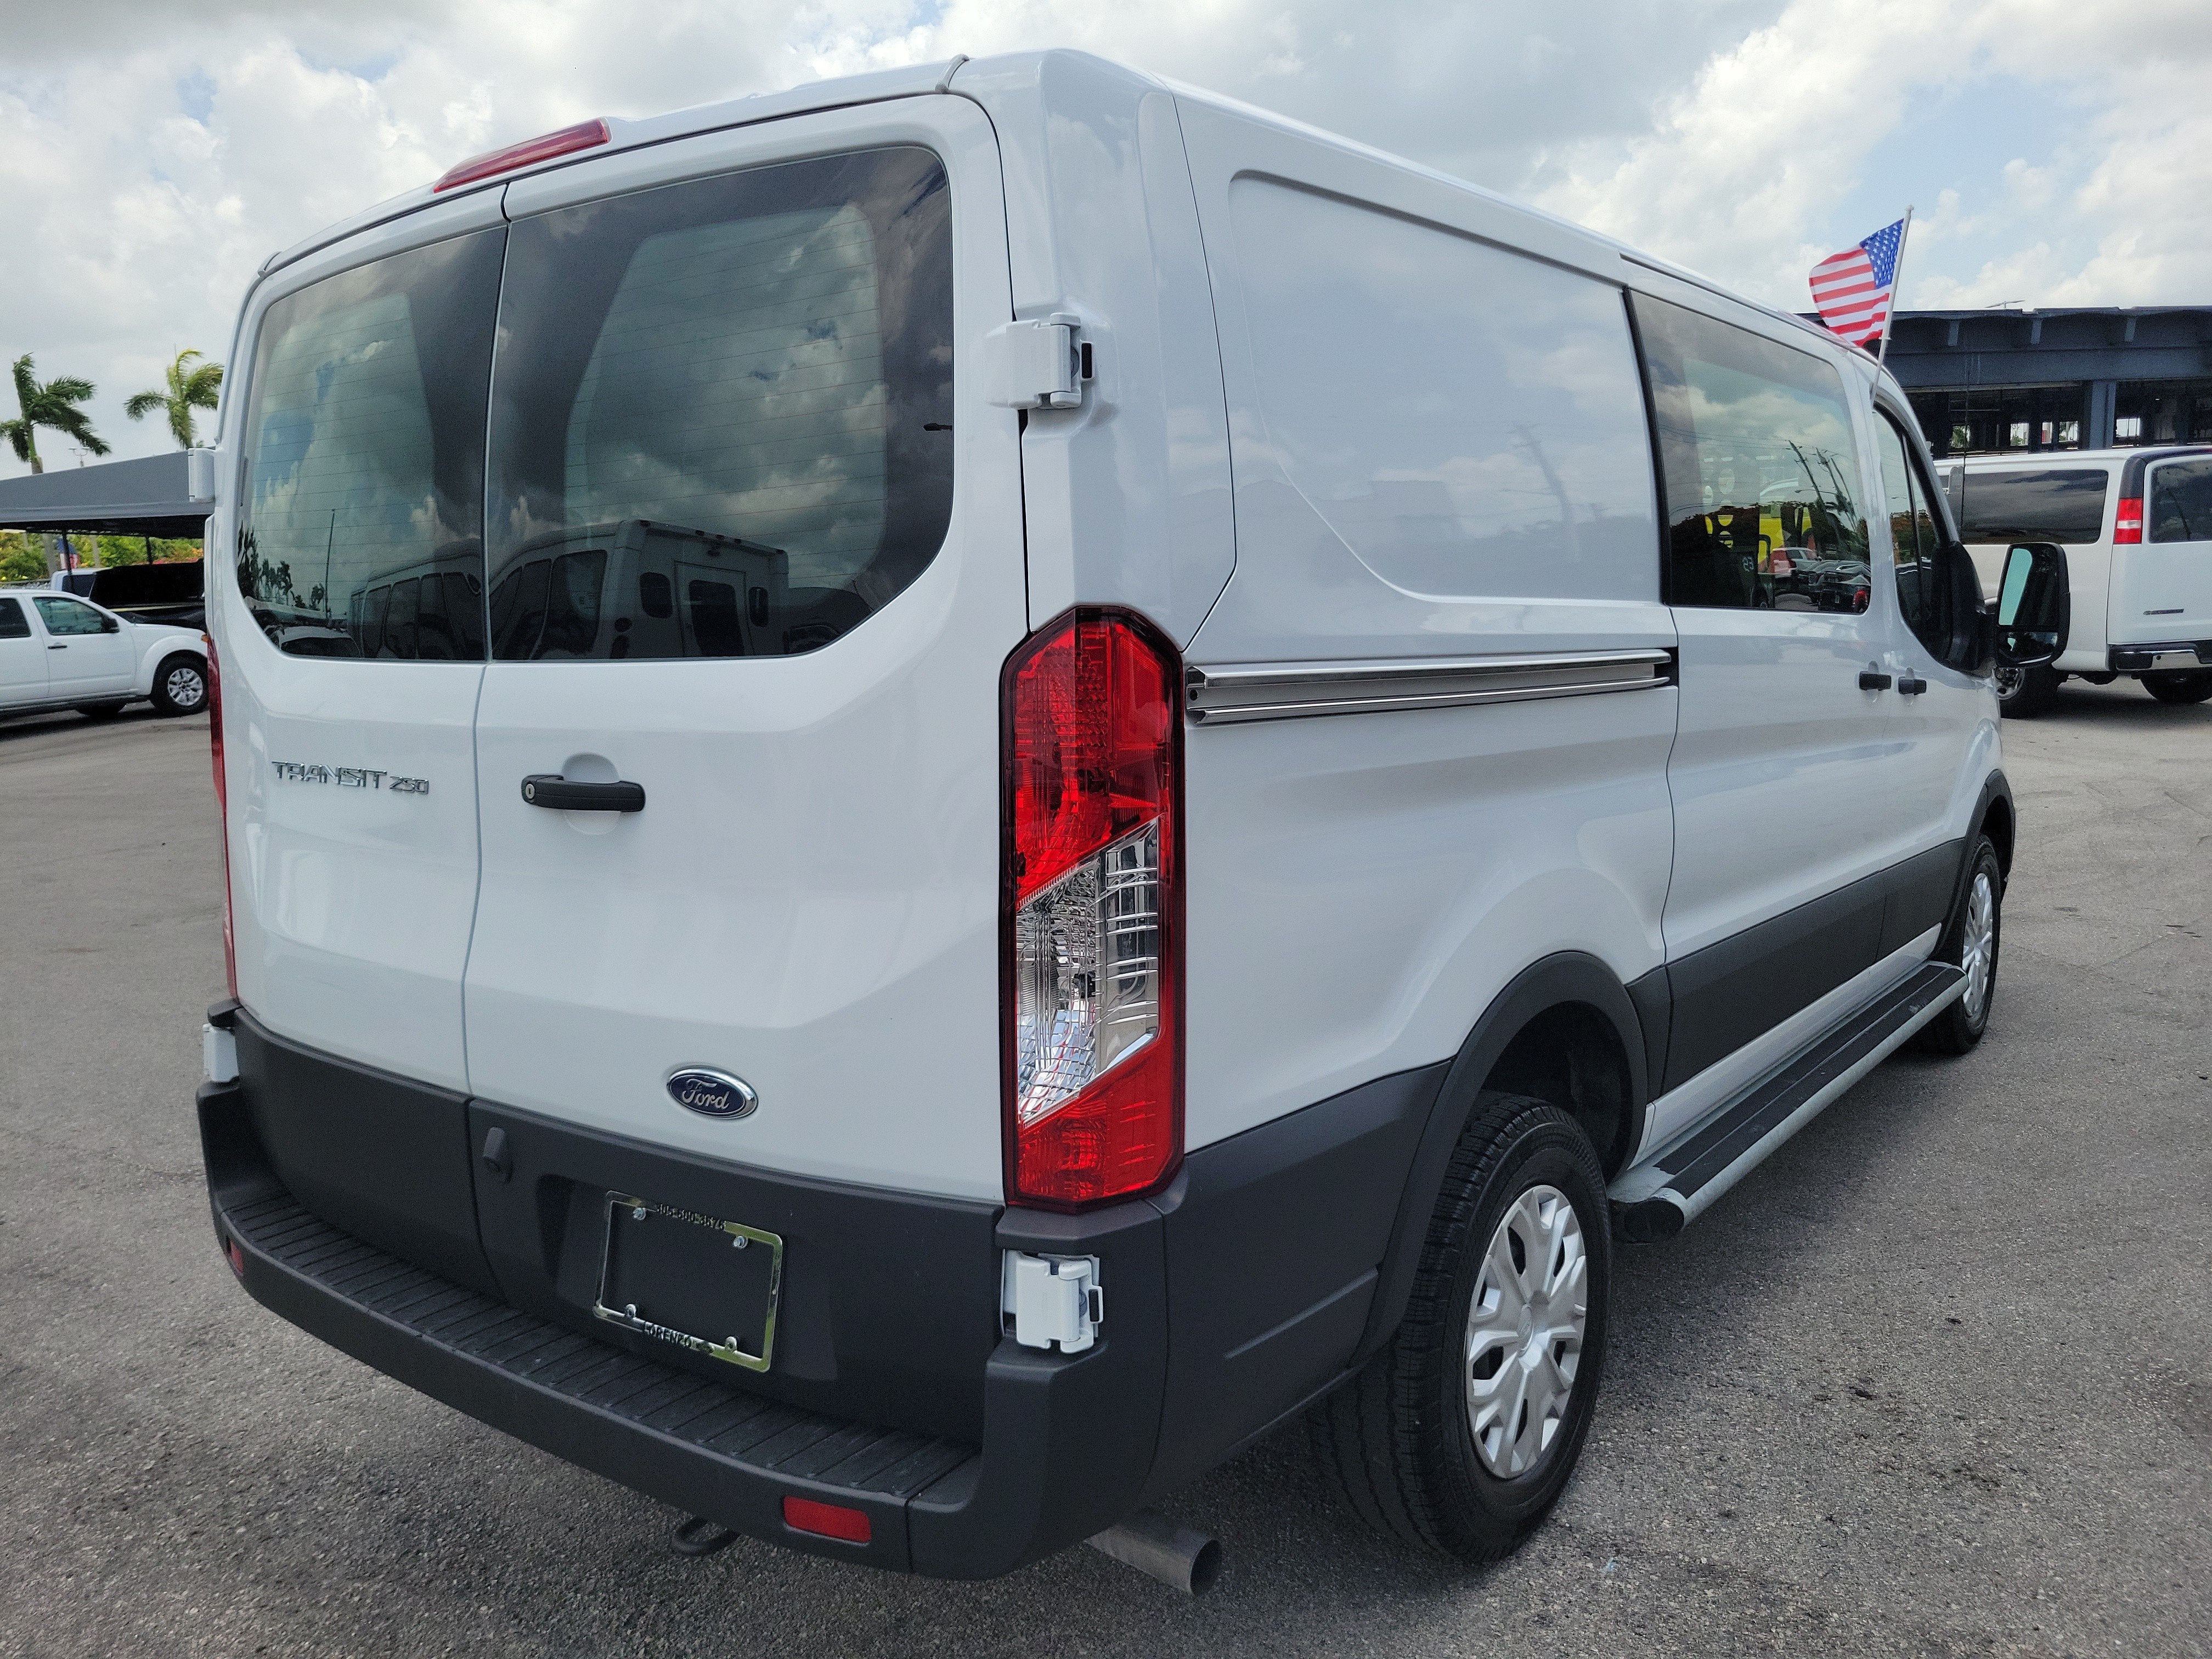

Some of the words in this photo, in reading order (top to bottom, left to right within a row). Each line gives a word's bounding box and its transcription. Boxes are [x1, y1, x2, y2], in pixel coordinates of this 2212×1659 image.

[272, 761, 387, 788] TRANSIT
[390, 776, 429, 794] 250
[681, 1079, 730, 1109] Ford
[644, 1321, 692, 1348] LORENZO
